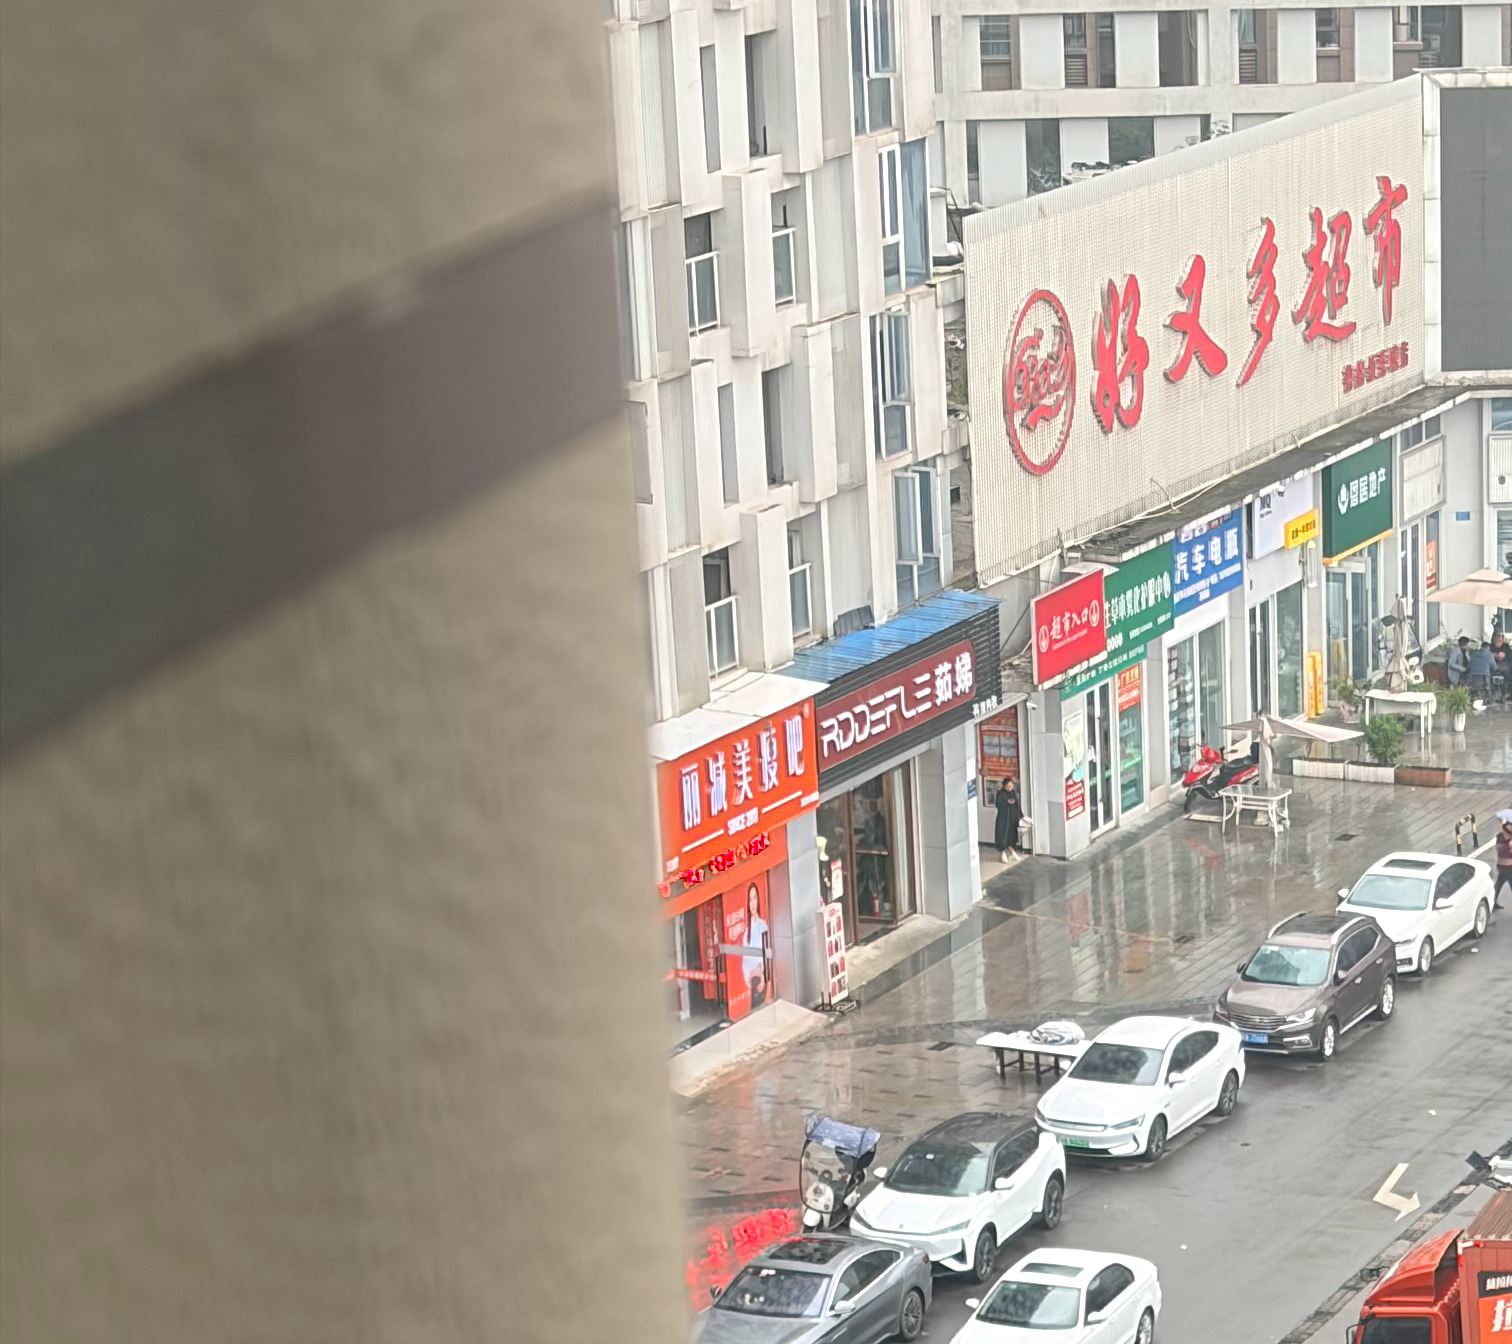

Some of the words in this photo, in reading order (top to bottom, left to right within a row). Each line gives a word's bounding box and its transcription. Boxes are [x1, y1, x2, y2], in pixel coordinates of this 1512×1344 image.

[1092, 176, 1408, 433] 好又多超市
[1174, 527, 1240, 585] 汽车电瓶
[1050, 607, 1089, 640] 超市入口
[680, 714, 805, 831] 丽减美瘦吧
